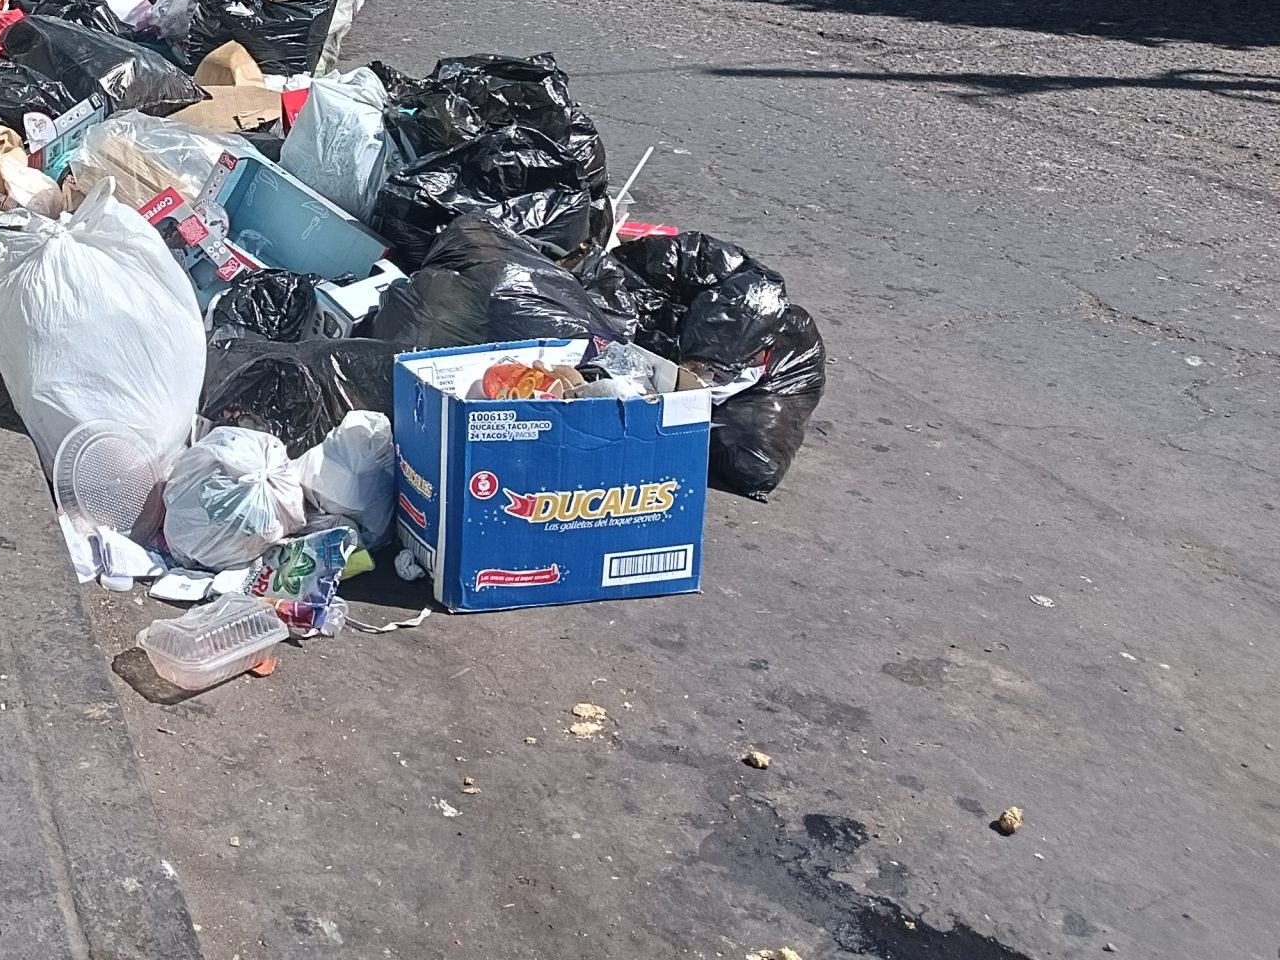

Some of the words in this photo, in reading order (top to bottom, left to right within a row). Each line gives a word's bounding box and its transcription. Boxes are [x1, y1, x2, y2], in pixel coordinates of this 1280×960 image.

[143, 196, 173, 220] COFFEE
[471, 413, 515, 422] 1006139
[530, 481, 677, 523] DUCALES
[544, 522, 559, 531] Las
[560, 520, 593, 532] galletas
[594, 519, 607, 527] del
[609, 517, 632, 527] toque
[632, 513, 661, 524] secreto
